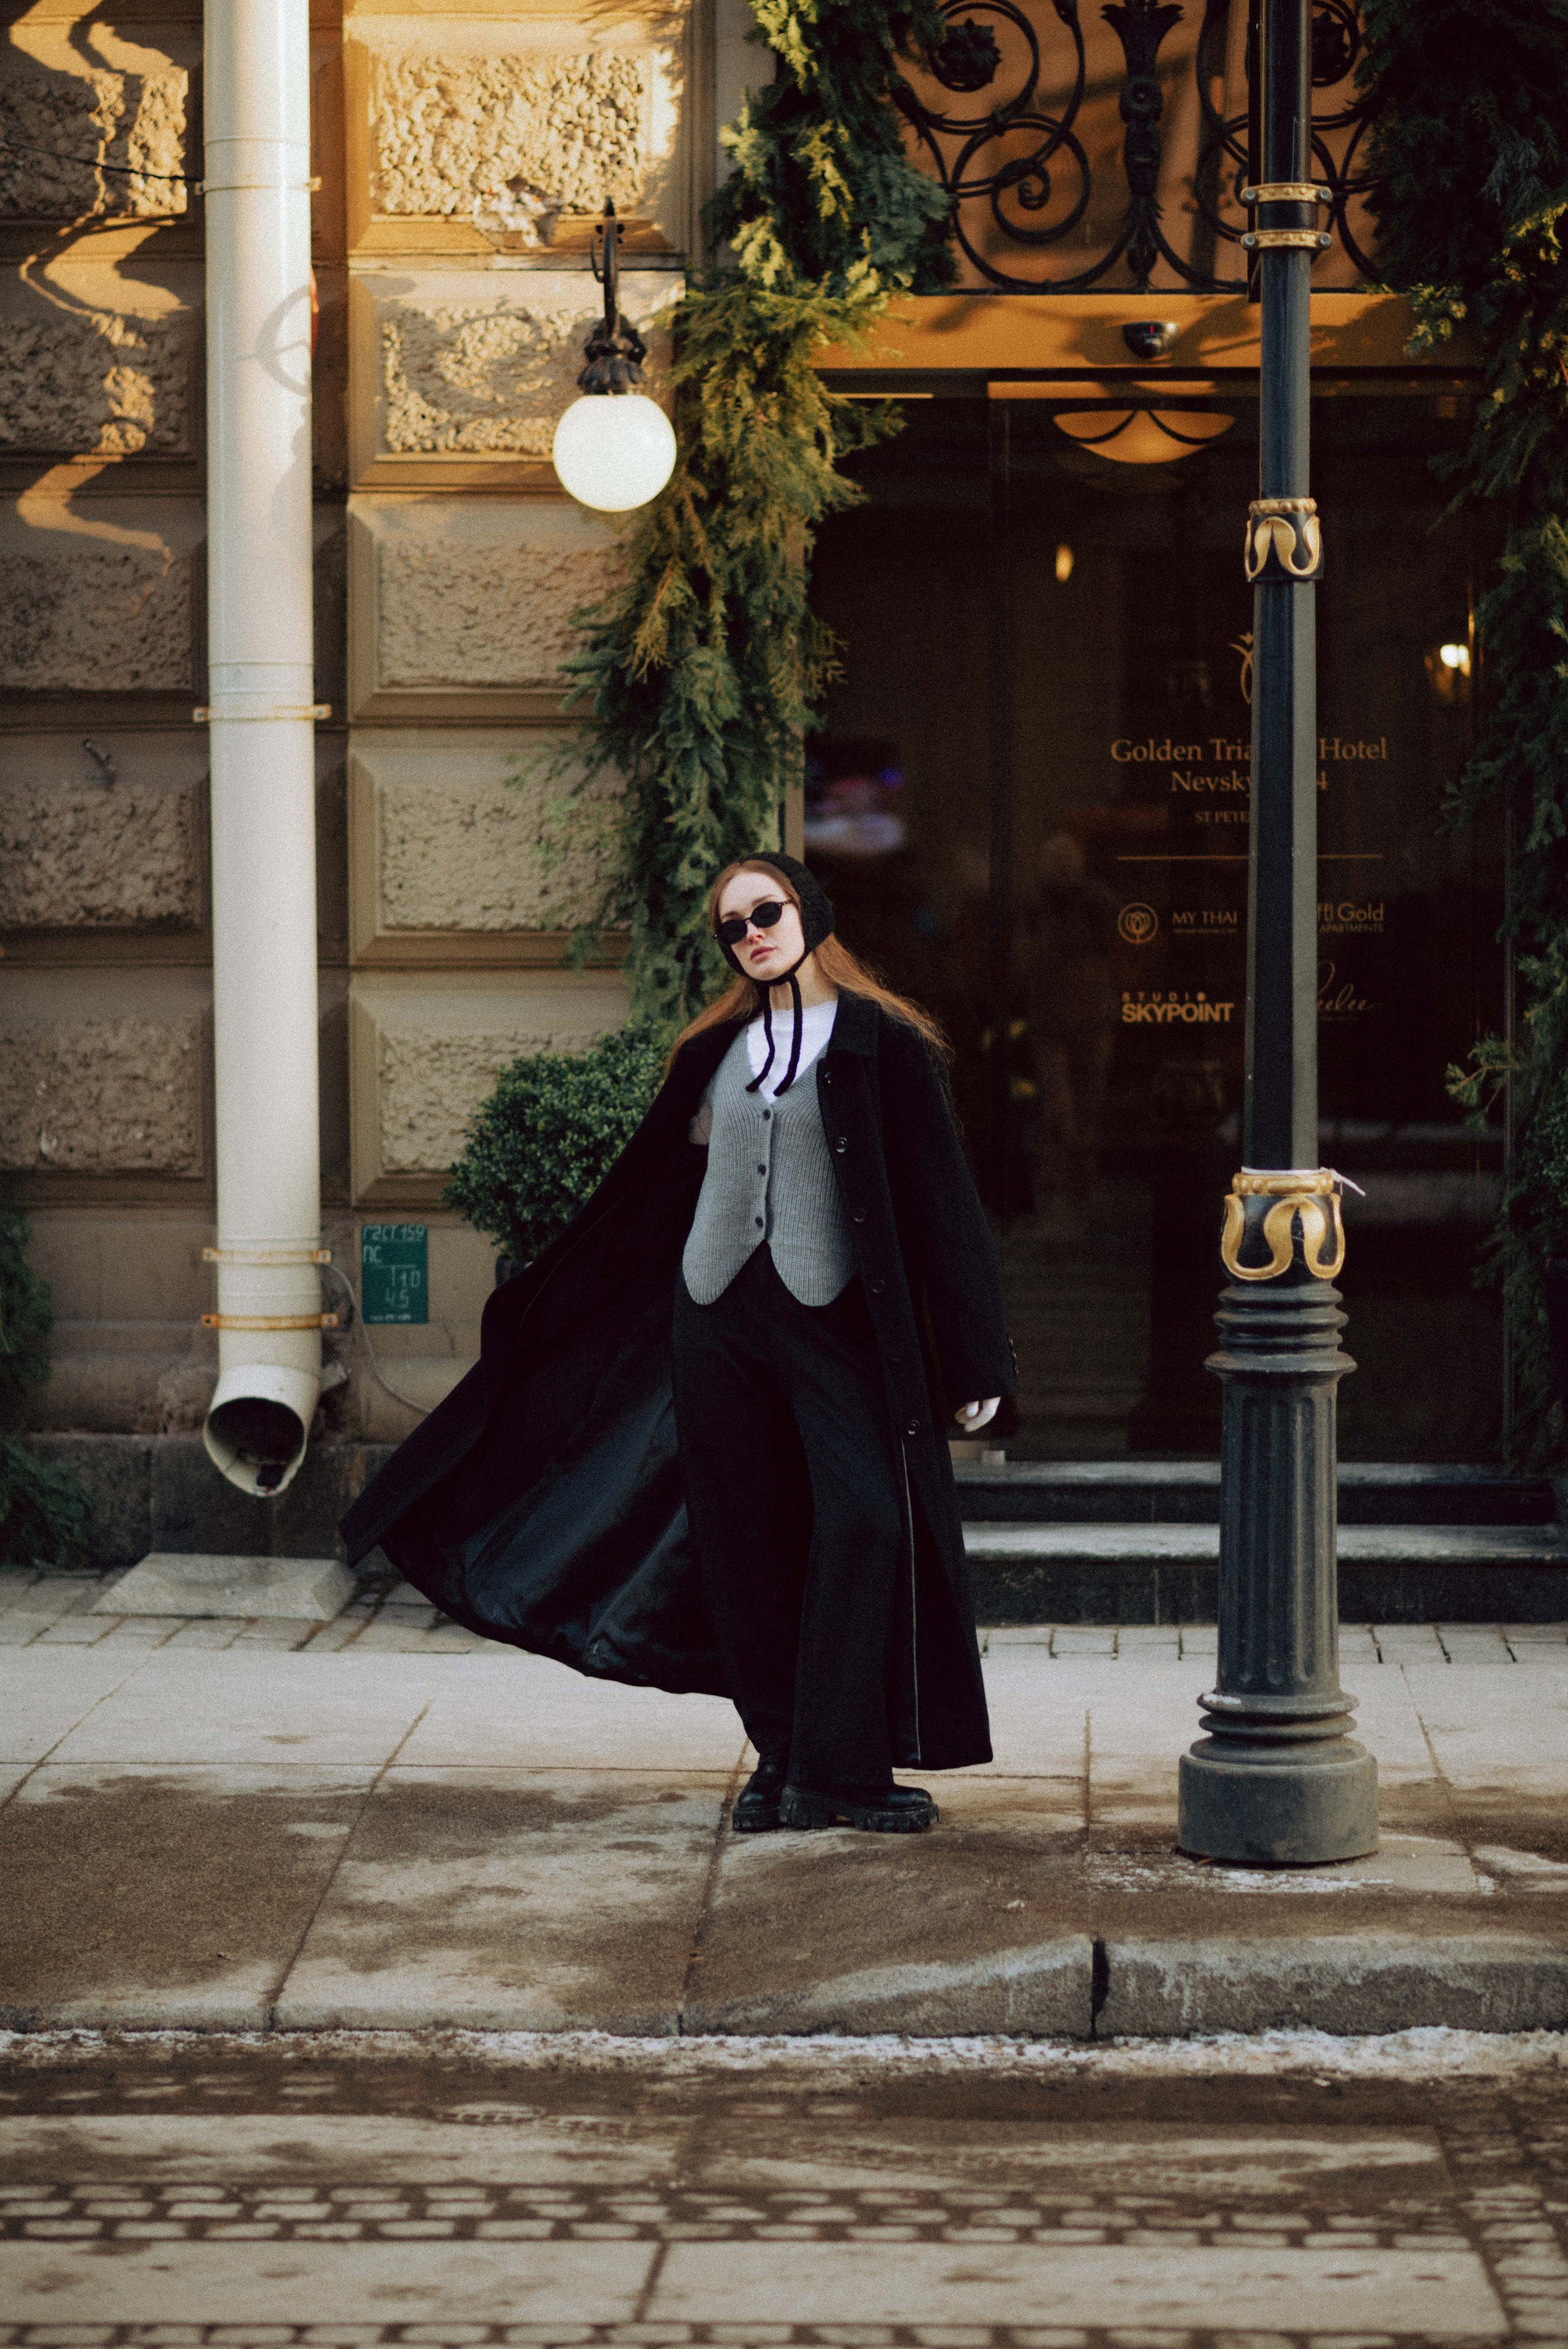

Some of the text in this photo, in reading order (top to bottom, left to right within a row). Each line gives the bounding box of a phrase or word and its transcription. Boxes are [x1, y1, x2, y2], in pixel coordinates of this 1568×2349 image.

[1110, 737, 1203, 763] Golden
[1319, 736, 1387, 761] Hotel
[1172, 910, 1238, 926] MY THAI
[1337, 901, 1384, 922] Gold
[1121, 1002, 1235, 1024] SKYPOINT
